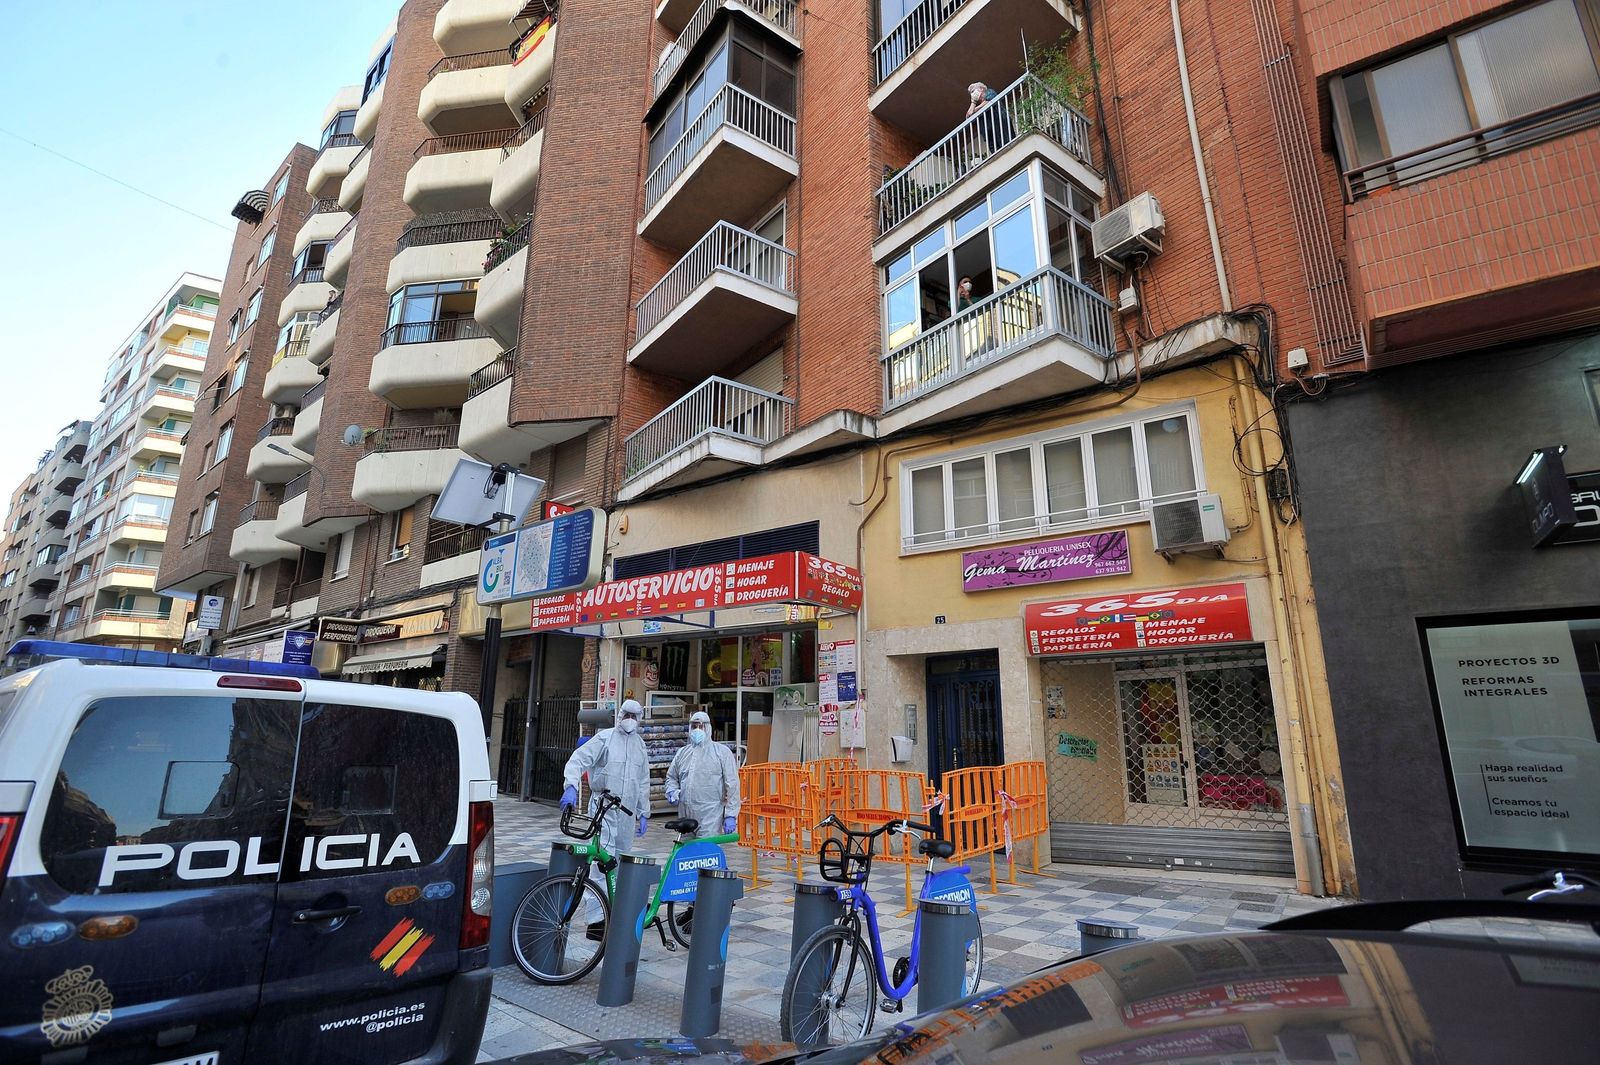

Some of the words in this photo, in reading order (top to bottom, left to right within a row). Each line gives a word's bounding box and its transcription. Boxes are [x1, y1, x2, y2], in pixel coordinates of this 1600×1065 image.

[1024, 545, 1065, 557] PELUQUERIA
[1066, 541, 1092, 551] UNISEX
[737, 560, 775, 574] MENAJE
[808, 556, 847, 577] 365
[964, 563, 1007, 583] Gema
[1016, 552, 1096, 572] Martínez
[583, 567, 714, 607] AUTOSERVICIO
[736, 575, 767, 587] HOGAR
[736, 586, 789, 601] DROGUERÍA
[821, 583, 850, 598] REGALO
[540, 594, 565, 605] REGALOS
[1040, 591, 1180, 617] 365
[1175, 594, 1228, 605] DIA
[539, 604, 575, 616] FERRETERÍA
[538, 615, 570, 626] PAPELERÍA
[1145, 617, 1206, 628] MENAJE
[364, 624, 396, 638] DROGUERIA
[1041, 626, 1096, 637] REGALOS
[1146, 627, 1196, 637] HOGAR
[1042, 632, 1120, 645] FERRETERÍA
[1148, 631, 1234, 645] DROGUERÍA
[1043, 641, 1113, 652] PAPELERÍA
[1458, 657, 1537, 667] PROYECTOS
[1542, 656, 1560, 665] 3D
[1462, 676, 1535, 685] REFORMAS
[1464, 687, 1548, 697] INTEGRALES
[1485, 764, 1514, 774] Haga
[1517, 764, 1563, 773] realidad
[1487, 775, 1505, 783] sus
[1508, 774, 1548, 783] sueños
[1492, 797, 1542, 807] Creamos
[1545, 799, 1557, 807] tu
[1494, 809, 1538, 818] espacio
[1541, 810, 1570, 818] ideal
[98, 832, 421, 887] POLICIA
[679, 856, 719, 871] DECATHLON
[320, 1002, 425, 1032] www.policia.es
[366, 1013, 424, 1033] @policia
